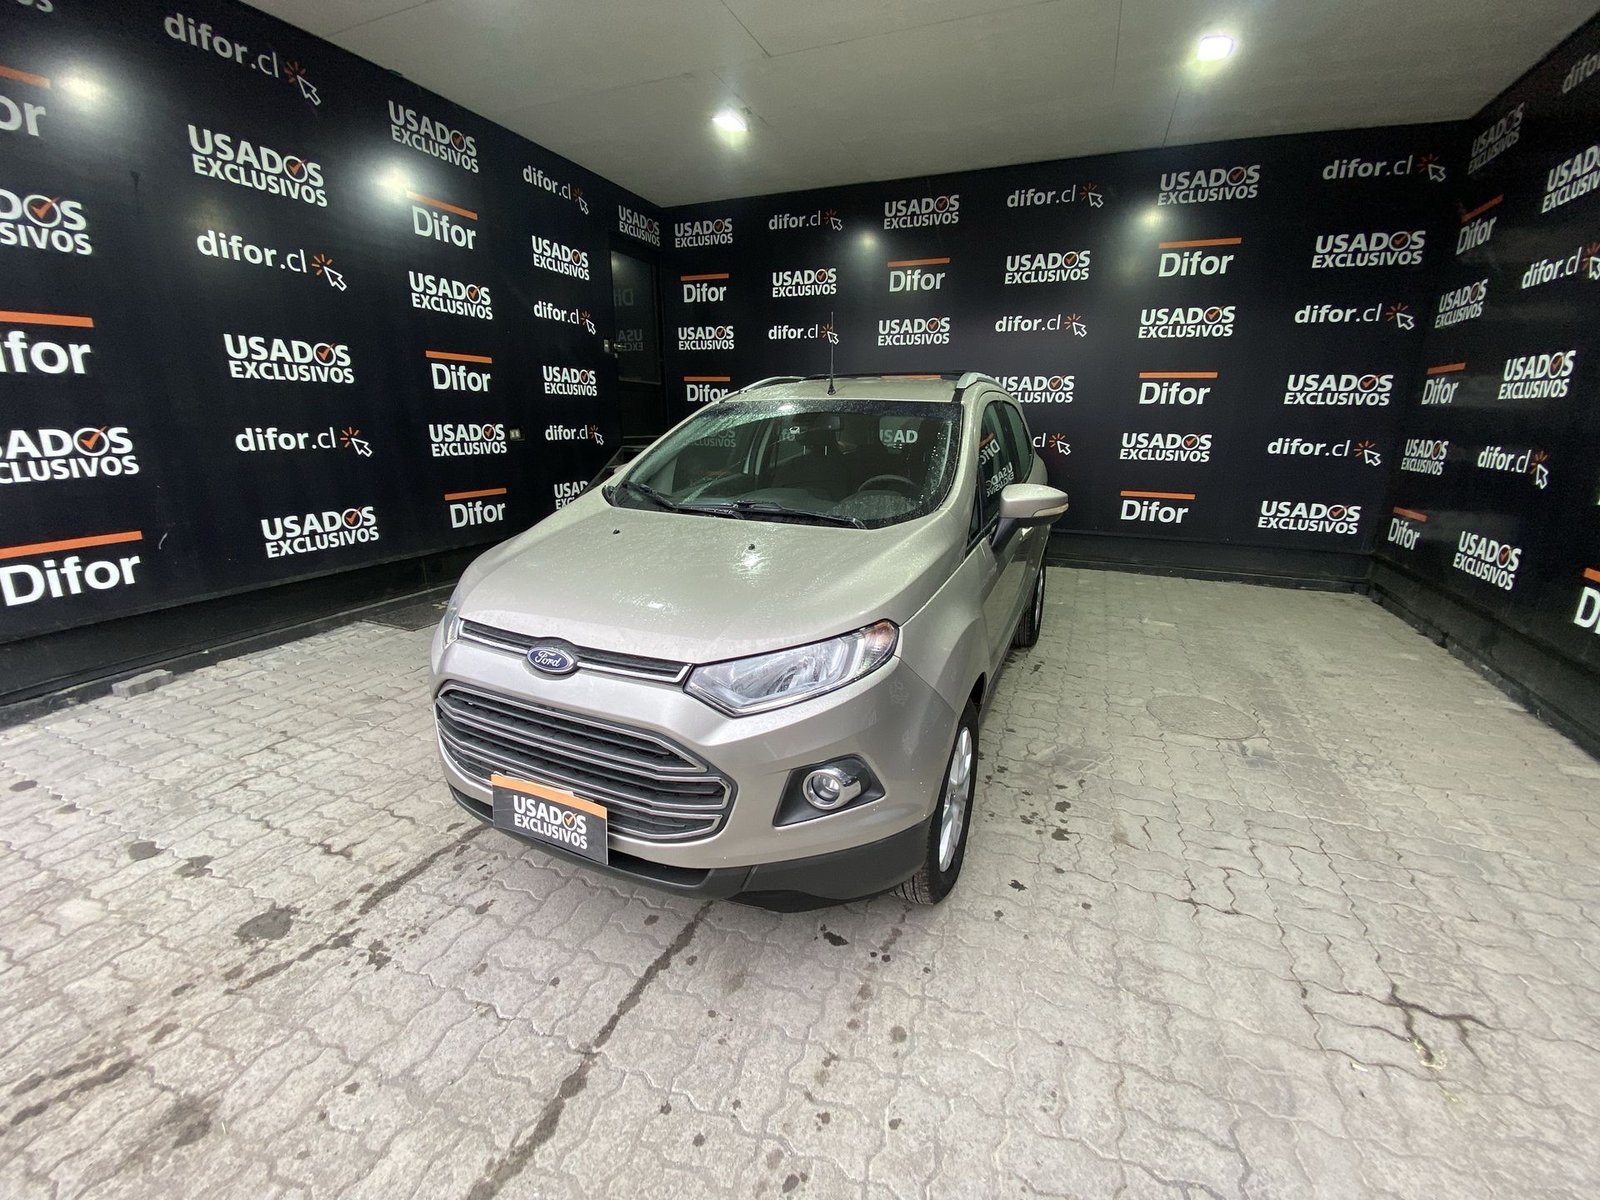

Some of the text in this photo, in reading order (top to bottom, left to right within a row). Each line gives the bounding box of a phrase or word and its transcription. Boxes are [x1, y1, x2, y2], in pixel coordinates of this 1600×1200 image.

[164, 13, 279, 78] difor.cl
[388, 100, 477, 157] USADOS
[188, 124, 324, 188] USADOS
[391, 123, 479, 174] EXCLUSIVOS
[192, 153, 328, 207] EXCLUSIVOS
[1160, 164, 1261, 192] USADOS
[1322, 155, 1413, 181] difor.cl
[522, 165, 572, 201] difor.cl
[884, 194, 960, 218] USADOS
[1006, 184, 1076, 209] difor.cl
[1157, 185, 1259, 207] EXCLUSIVOS
[411, 205, 477, 250] Difor
[618, 205, 660, 236] USADOS
[674, 218, 733, 237] USADOS
[768, 210, 821, 231] difor.cl
[883, 211, 960, 230] EXCLUSIVOS
[619, 221, 661, 247] EXCLUSIVOS
[675, 233, 733, 248] EXCLUSIVOS
[1314, 230, 1426, 255] USADOS
[1455, 216, 1497, 256] Difor
[196, 229, 307, 273] difor.cl
[531, 235, 589, 268] USADOS
[1005, 250, 1091, 272] USADOS
[1311, 249, 1424, 270] EXCLUSIVOS
[533, 253, 590, 281] EXCLUSIVOS
[1158, 250, 1234, 278] Difor
[1521, 246, 1582, 290] difor.cl
[408, 270, 491, 306] USADOS
[772, 268, 837, 285] USADOS
[889, 270, 945, 293] Difor
[1004, 268, 1089, 285] EXCLUSIVOS
[683, 283, 727, 303] Difor
[772, 282, 837, 298] EXCLUSIVOS
[1439, 278, 1488, 313] USADOS
[411, 292, 493, 321] EXCLUSIVOS
[533, 301, 580, 325] difor.cl
[1140, 305, 1236, 327] USADOS
[1294, 303, 1382, 325] difor.cl
[1434, 301, 1483, 328] EXCLUSIVOS
[678, 326, 734, 340] USADOS
[768, 324, 819, 340] difor.cl
[878, 317, 950, 335] USADOS
[994, 314, 1061, 333] difor.cl
[1138, 323, 1233, 339] EXCLUSIVOS
[223, 333, 351, 366] USADOS
[678, 339, 735, 351] EXCLUSIVOS
[877, 331, 950, 347] EXCLUSIVOS
[229, 360, 355, 384] EXCLUSIVOS
[430, 363, 491, 392] Difor
[542, 365, 596, 385] USADOS
[1503, 350, 1576, 382] USADOS
[544, 381, 598, 397] EXCLUSIVOS
[1139, 381, 1210, 405] Difor
[1287, 374, 1394, 393] USADOS
[1421, 378, 1459, 405] Difor
[1498, 379, 1570, 400] EXCLUSIVOS
[1283, 390, 1391, 407] EXCLUSIVOS
[0, 426, 134, 459] ADOS
[235, 426, 337, 452] difor.cl
[428, 423, 505, 443] USADOS
[545, 424, 589, 443] difor.cl
[1121, 432, 1212, 452] USADOS
[431, 440, 507, 457] EXCLUSIVOS
[1119, 447, 1210, 463] EXCLUSIVOS
[1267, 438, 1350, 457] difor.cl
[1404, 439, 1449, 460] USADOS
[1401, 457, 1444, 476] EXCLUSIVOS
[1477, 446, 1531, 474] difor.cl
[450, 500, 506, 529] Difor
[1120, 500, 1188, 524] Difor
[1260, 500, 1361, 522] USADOS
[260, 506, 377, 541] USADOS
[1257, 516, 1359, 535] EXCLUSIVOS
[1387, 518, 1420, 551] Difor
[265, 526, 380, 558] EXCLUSIVOS
[1458, 530, 1522, 571] USADOS
[0, 555, 141, 606] Difor
[1453, 552, 1516, 591] EXCLUSIVOS
[536, 649, 562, 668] Ford
[513, 795, 587, 834] USADOS
[514, 813, 588, 849] EXCLUSIVOS
